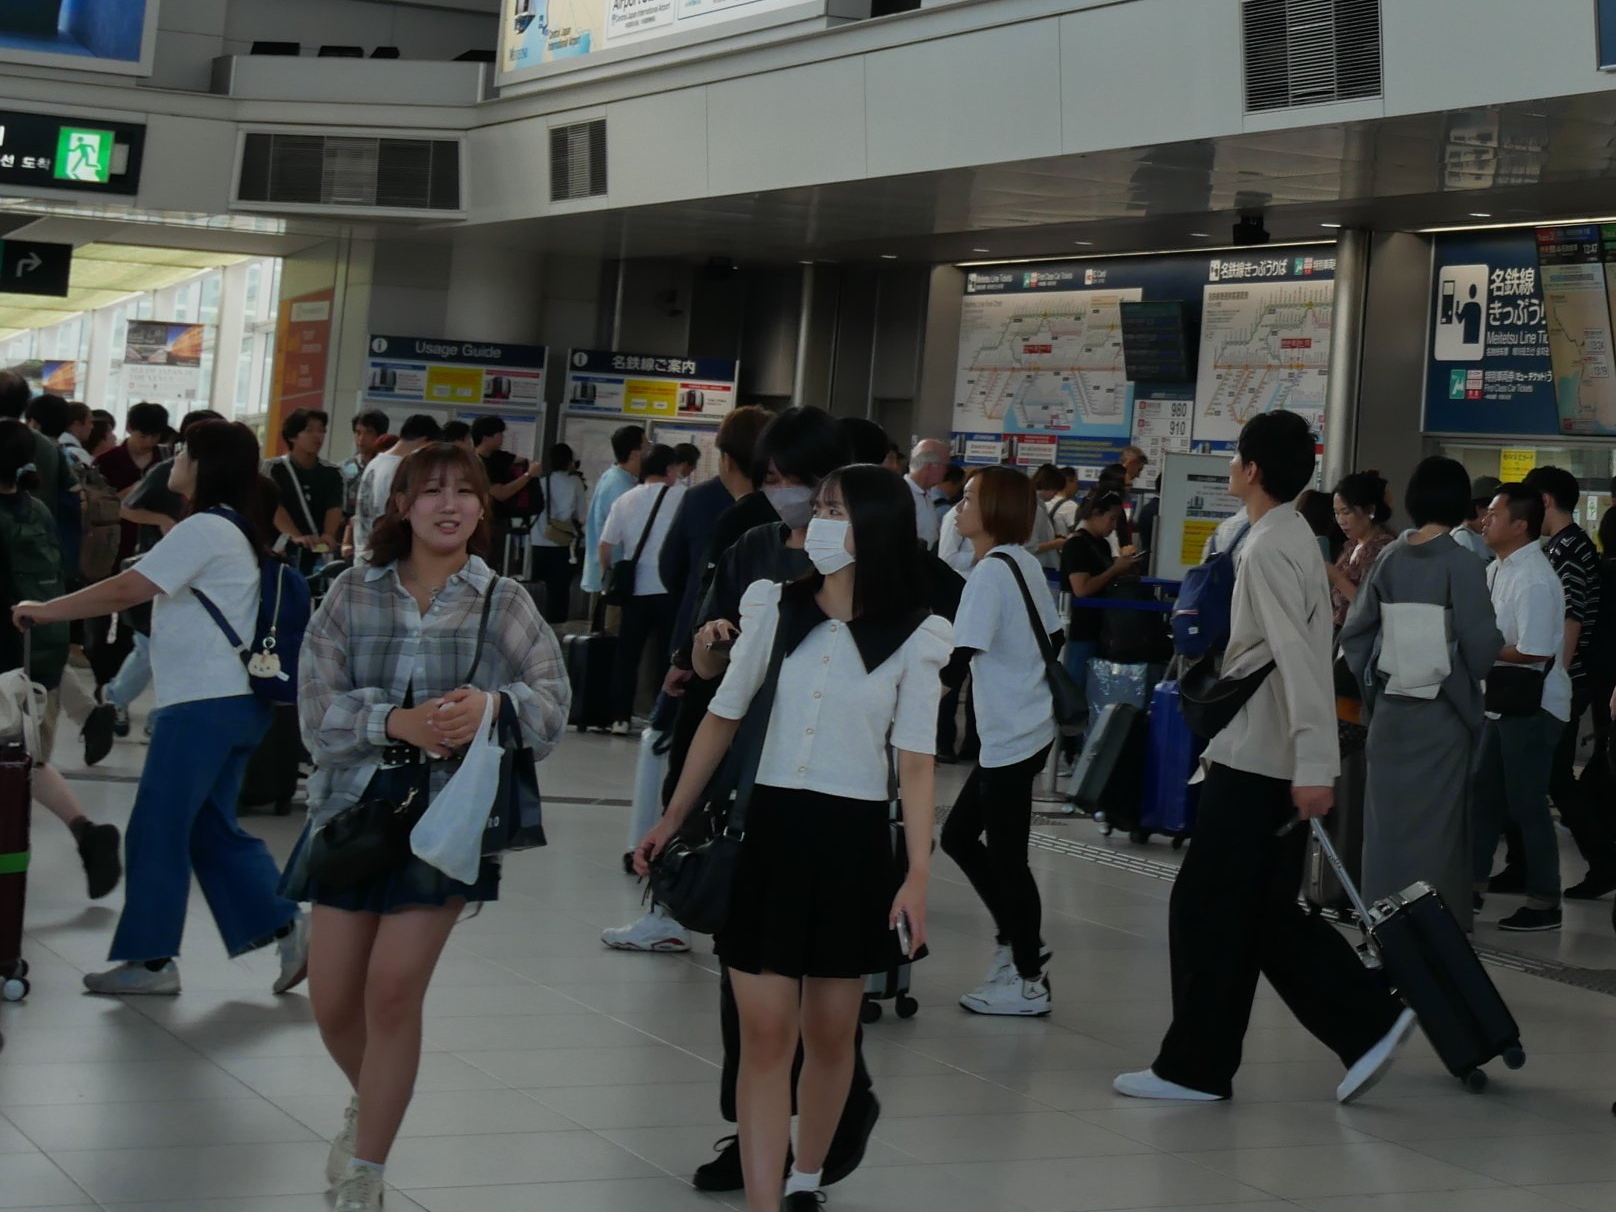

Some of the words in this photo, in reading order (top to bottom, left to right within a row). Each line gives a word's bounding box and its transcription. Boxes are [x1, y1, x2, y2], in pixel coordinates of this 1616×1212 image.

[1490, 267, 1536, 296] 名鉄線
[1519, 330, 1536, 344] Line
[415, 339, 458, 359] Usage
[462, 341, 502, 359] Guide
[612, 354, 697, 376] 名鉄線ご案内
[1169, 421, 1186, 436] 910
